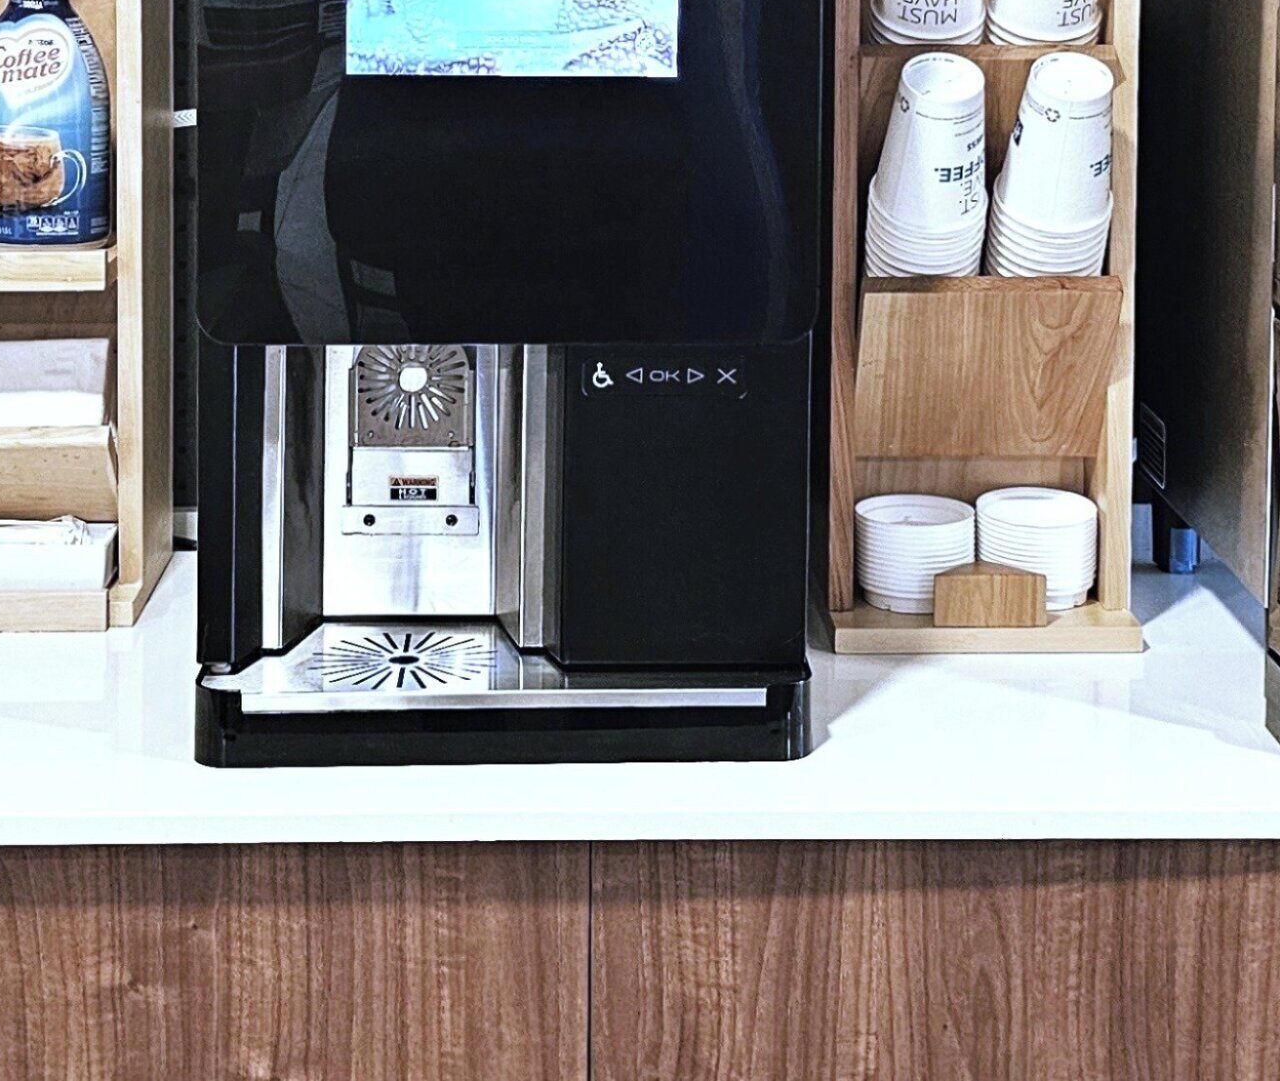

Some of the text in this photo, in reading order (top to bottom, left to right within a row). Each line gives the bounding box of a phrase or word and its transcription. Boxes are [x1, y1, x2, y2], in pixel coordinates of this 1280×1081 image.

[897, 2, 958, 26] MUST.
[1056, 3, 1095, 27] UST.
[2, 61, 61, 83] mate
[959, 192, 980, 216] ST.
[649, 370, 680, 382] OK
